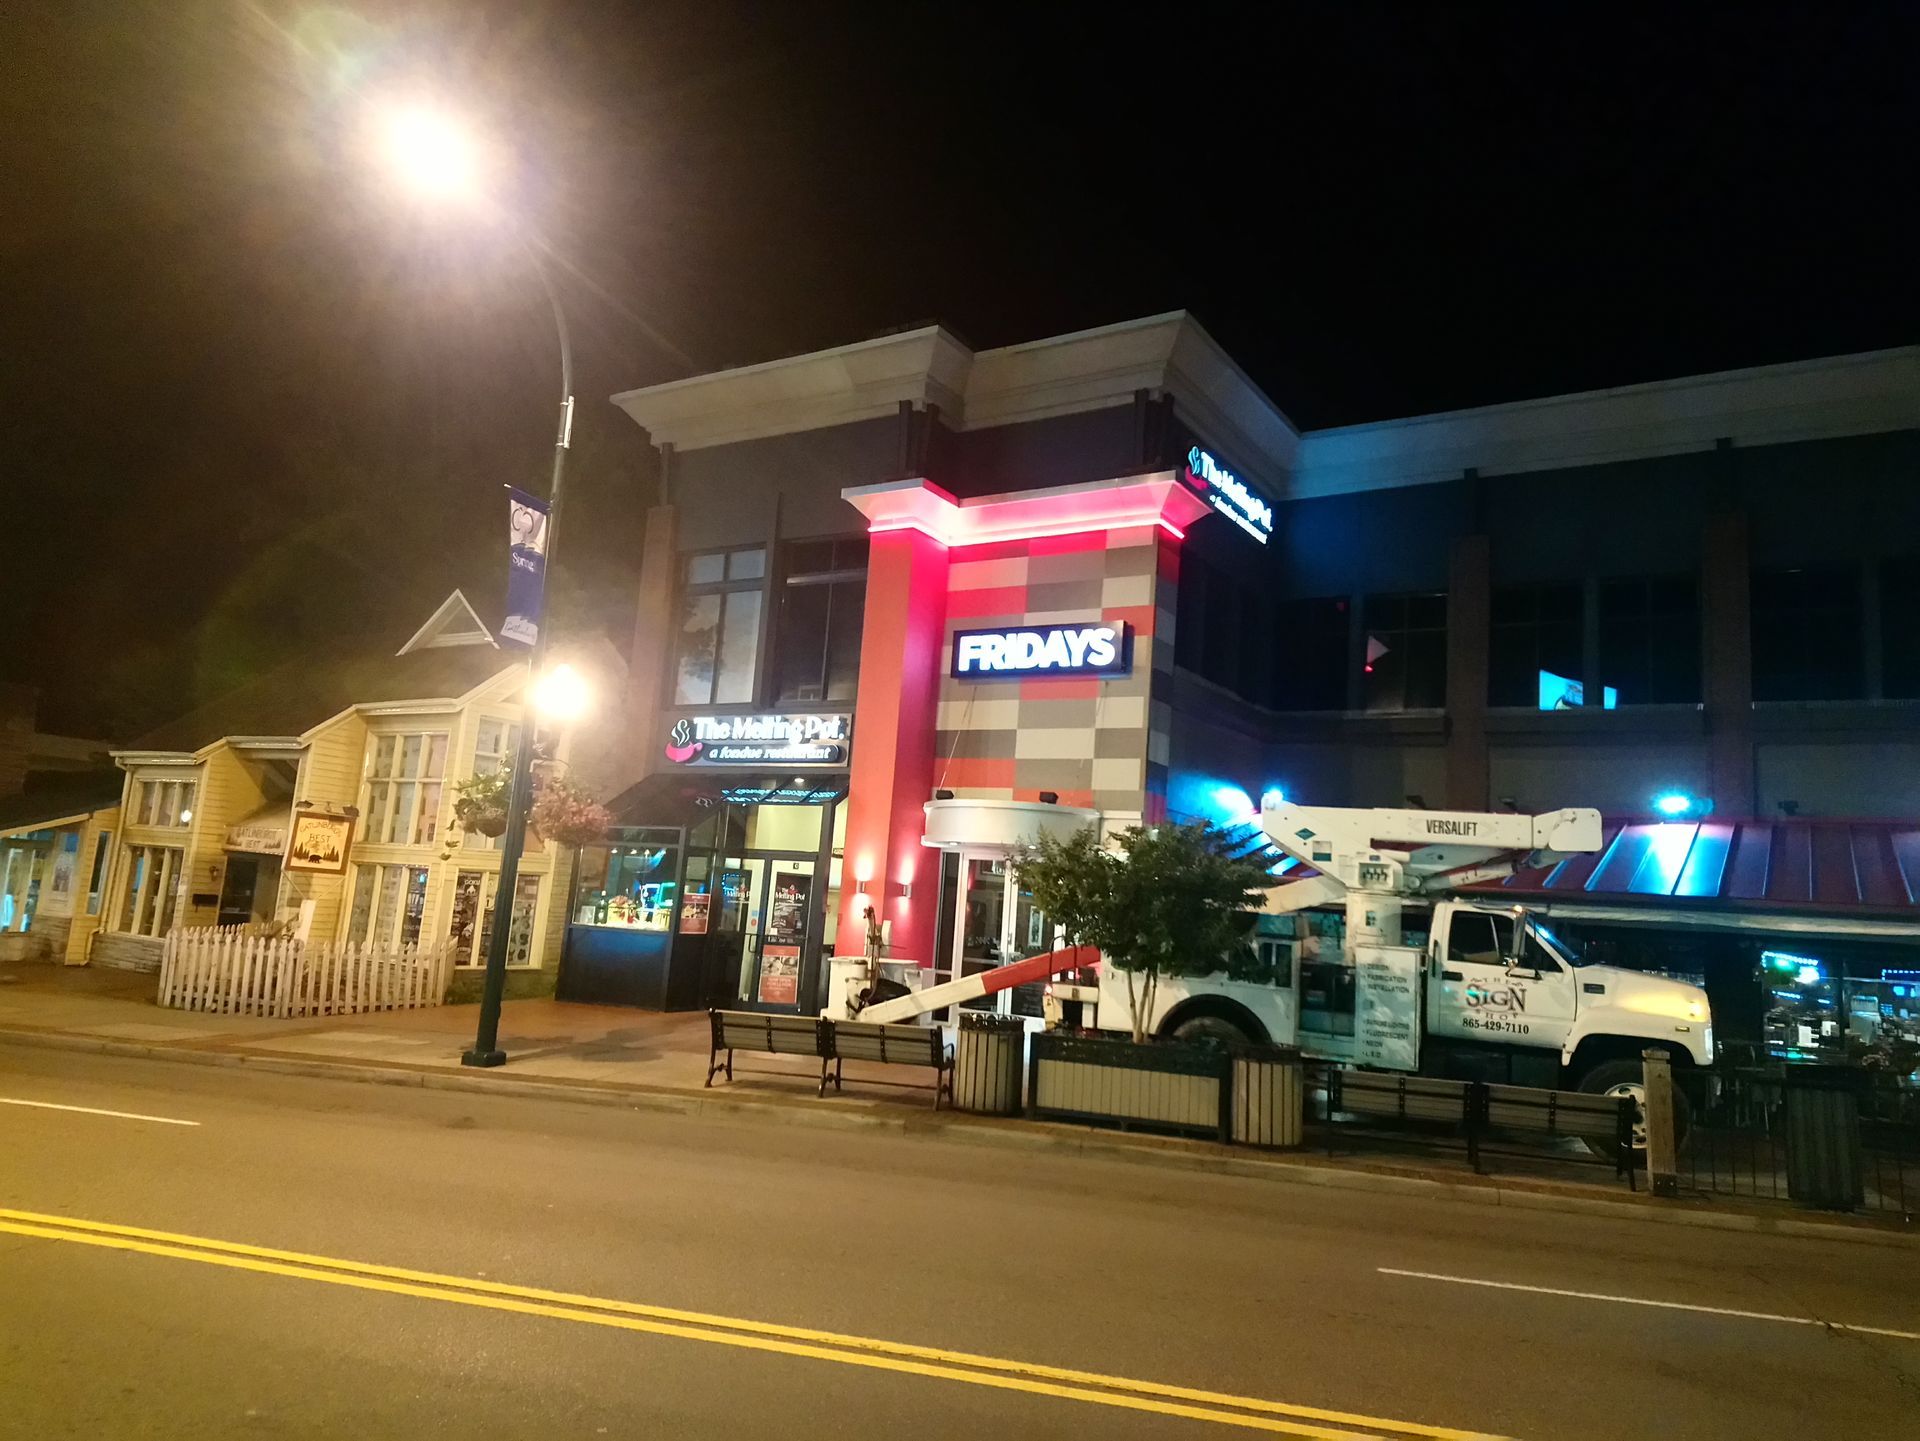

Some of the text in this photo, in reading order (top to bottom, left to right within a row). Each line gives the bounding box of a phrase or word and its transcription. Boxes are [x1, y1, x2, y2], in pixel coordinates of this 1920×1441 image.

[512, 552, 535, 573] Spring
[958, 627, 1116, 672] FRIDAYS
[693, 716, 731, 740] The
[731, 715, 804, 746] Melting
[719, 746, 763, 759] fondue
[1426, 819, 1478, 837] VERSALIFT
[775, 891, 806, 901] Melting Pot
[1465, 984, 1527, 1013] SIGN
[1462, 1018, 1530, 1035] 865-429-7110
